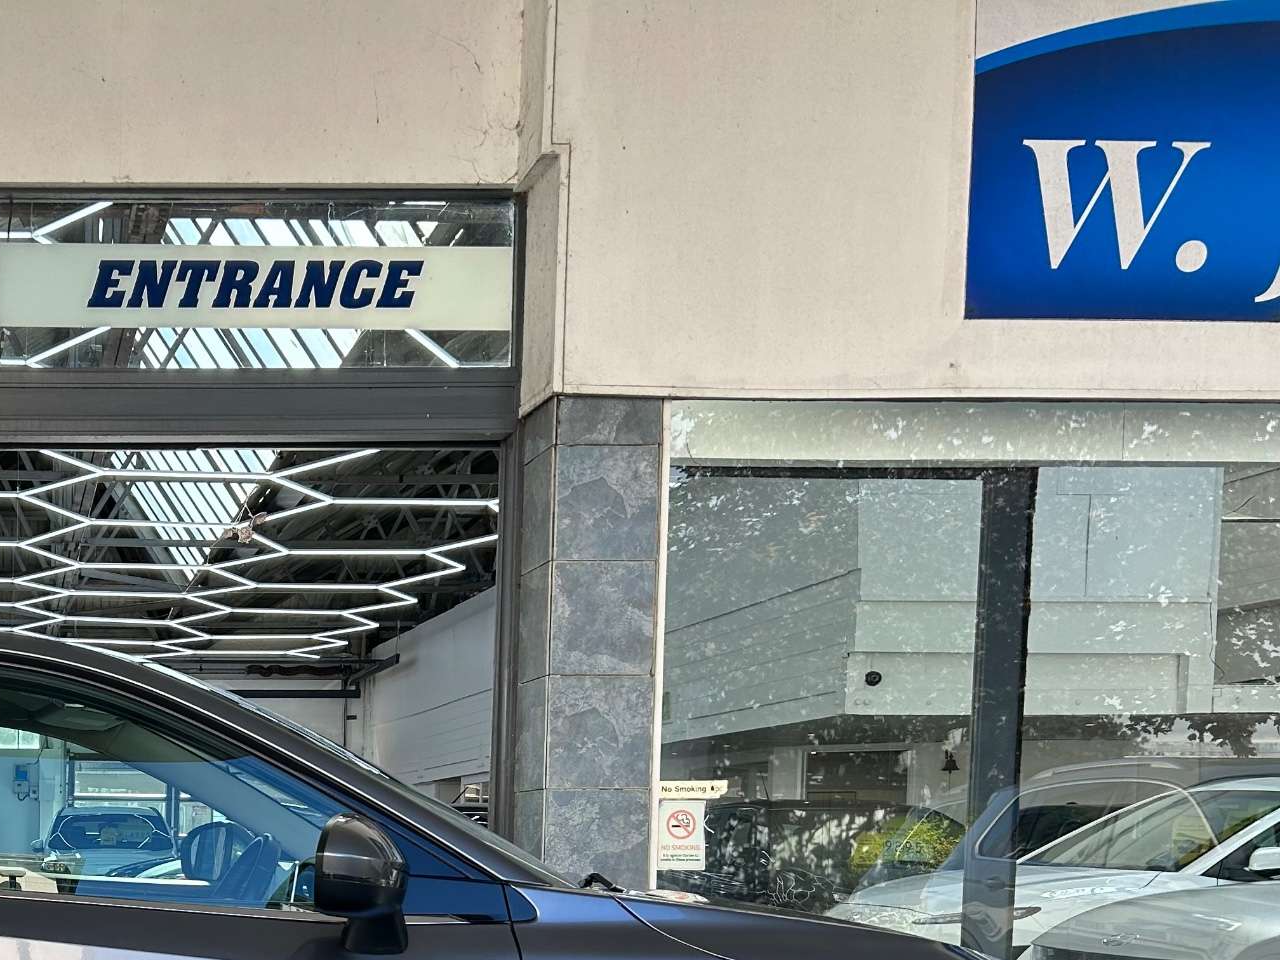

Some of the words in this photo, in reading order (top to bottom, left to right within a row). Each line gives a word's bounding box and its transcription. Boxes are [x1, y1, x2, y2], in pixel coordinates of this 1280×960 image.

[1022, 139, 1212, 273] W.
[86, 259, 425, 309] ENTRANCE
[674, 785, 707, 794] Smoking
